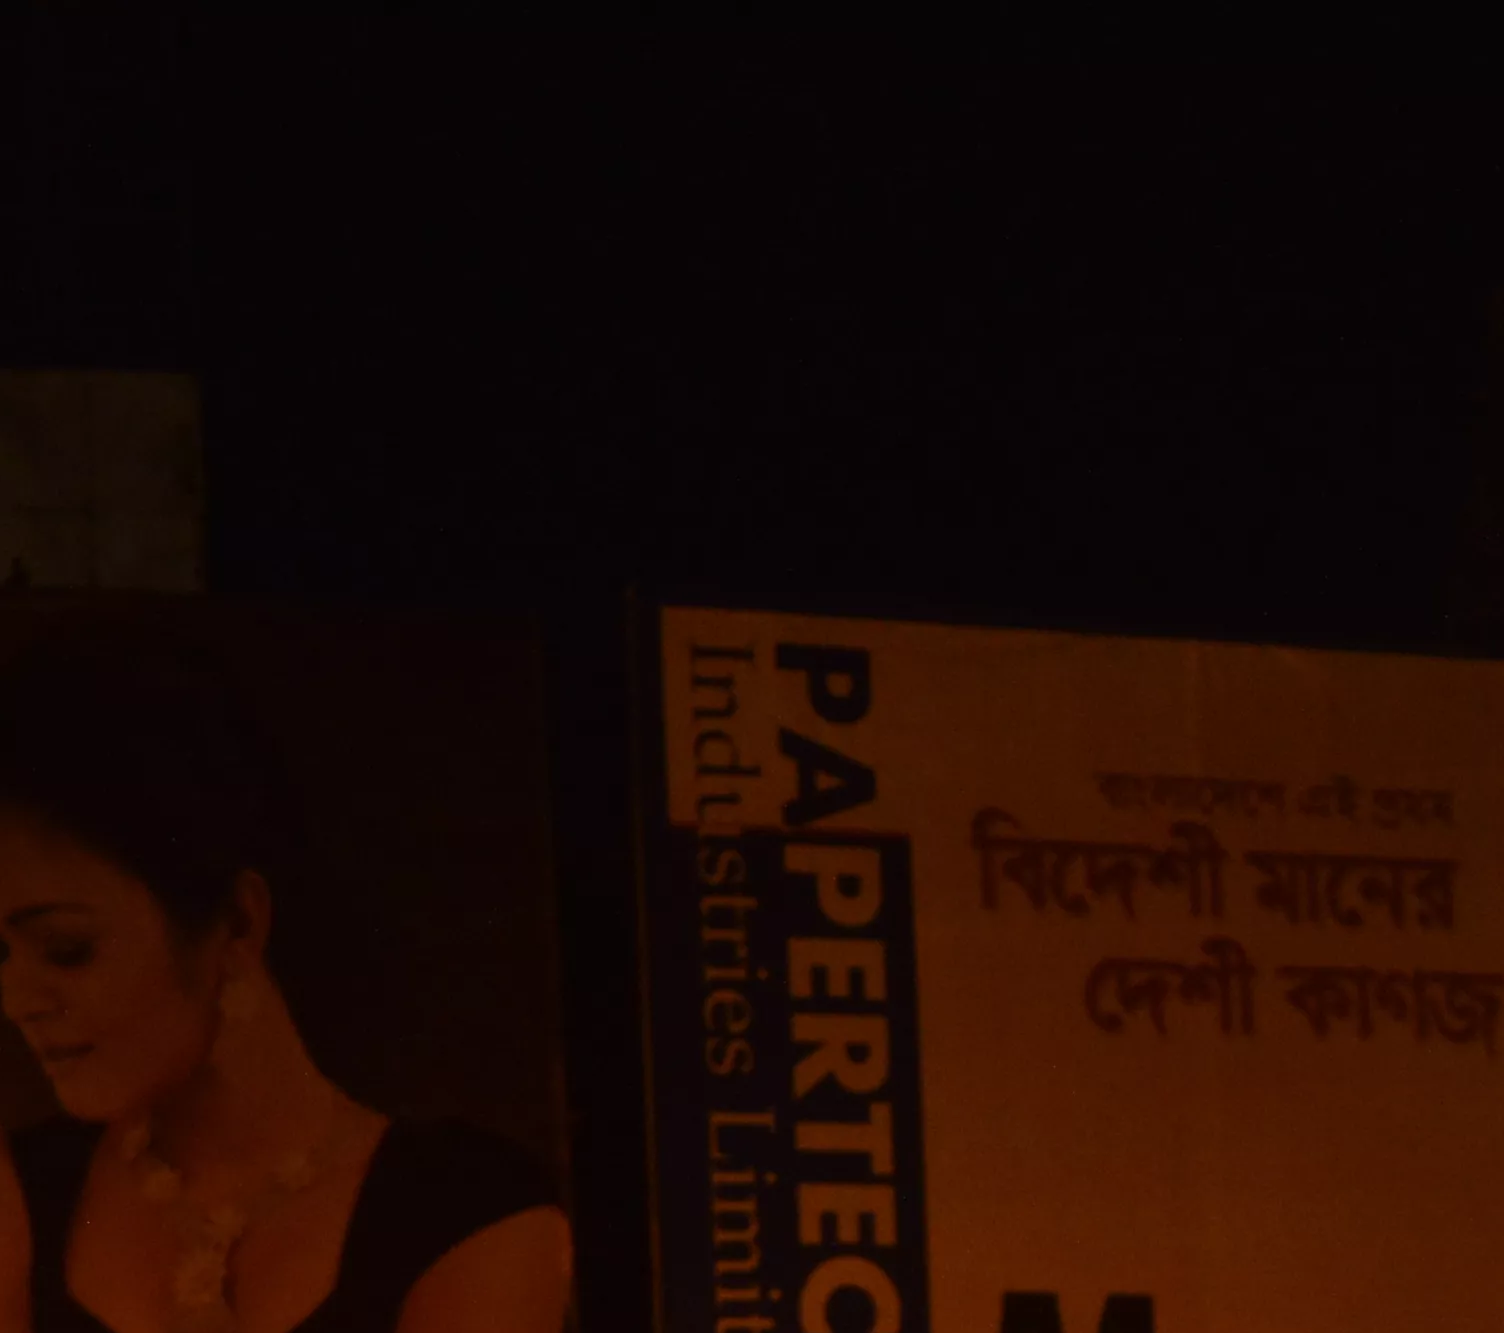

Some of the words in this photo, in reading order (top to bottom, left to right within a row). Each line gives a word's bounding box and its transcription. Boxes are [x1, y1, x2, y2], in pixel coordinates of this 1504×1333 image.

[692, 644, 772, 1078] Industries
[971, 806, 1226, 920] বিদেশী
[1242, 850, 1458, 930] মানের
[1085, 935, 1256, 1036] দেশী
